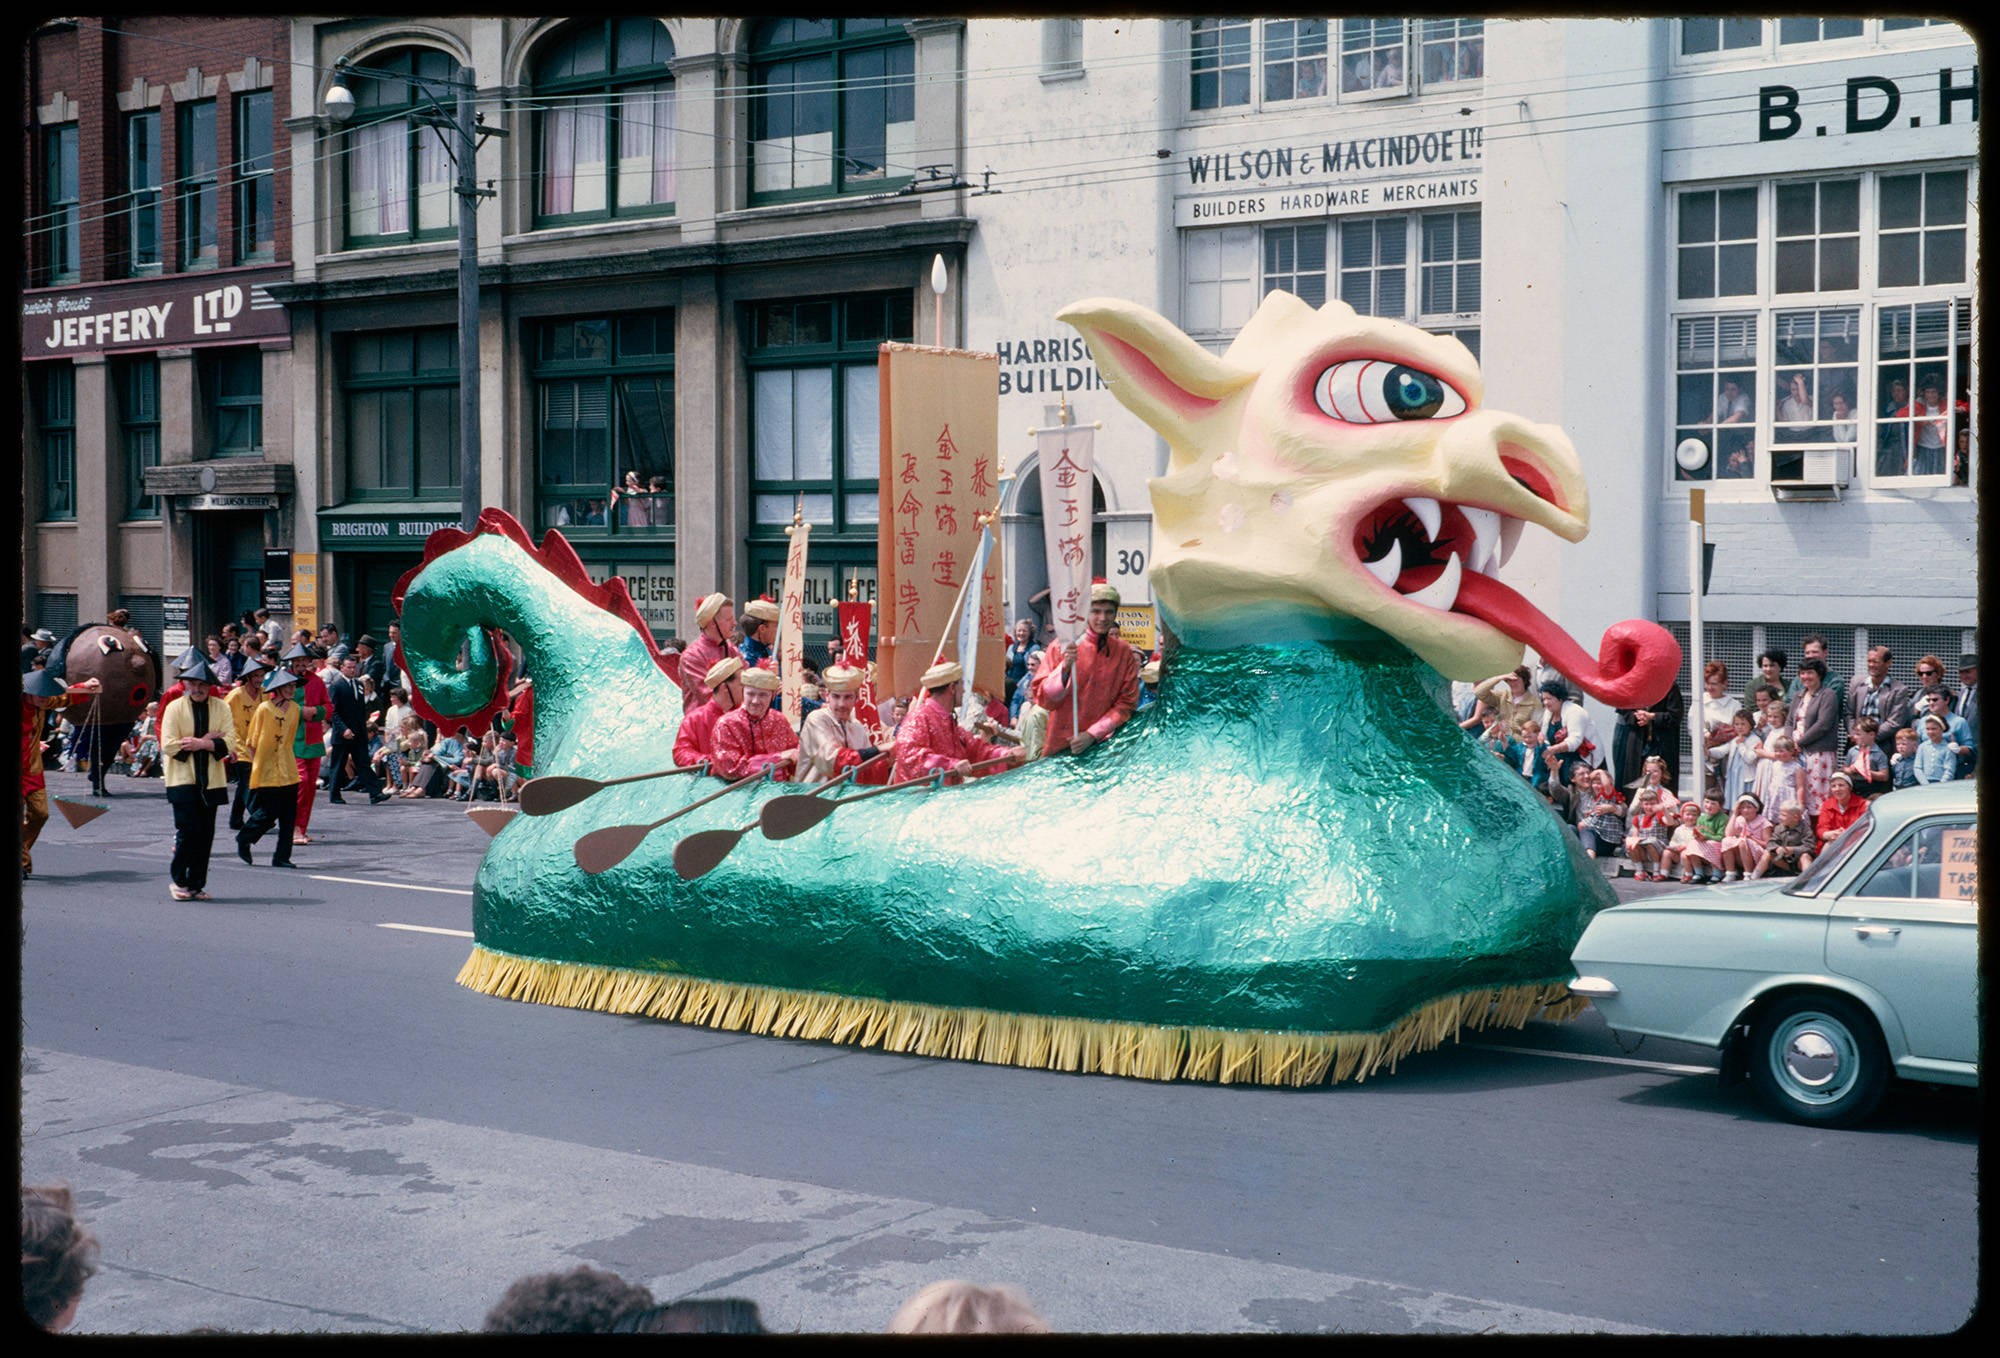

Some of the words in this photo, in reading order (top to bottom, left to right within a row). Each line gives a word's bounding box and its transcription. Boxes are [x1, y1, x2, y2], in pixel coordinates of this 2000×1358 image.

[1188, 147, 1293, 184] WILSON
[1299, 153, 1315, 175] &
[1322, 130, 1453, 173] MACINDOE
[1193, 198, 1266, 218] BUILDERS
[1281, 188, 1370, 211] HARDWARE
[1383, 179, 1479, 202] MERCHANTS
[45, 302, 173, 348] JEFFERY
[193, 284, 243, 334] LTD
[332, 522, 389, 536] BRIGHTON
[1117, 549, 1144, 576] 30
